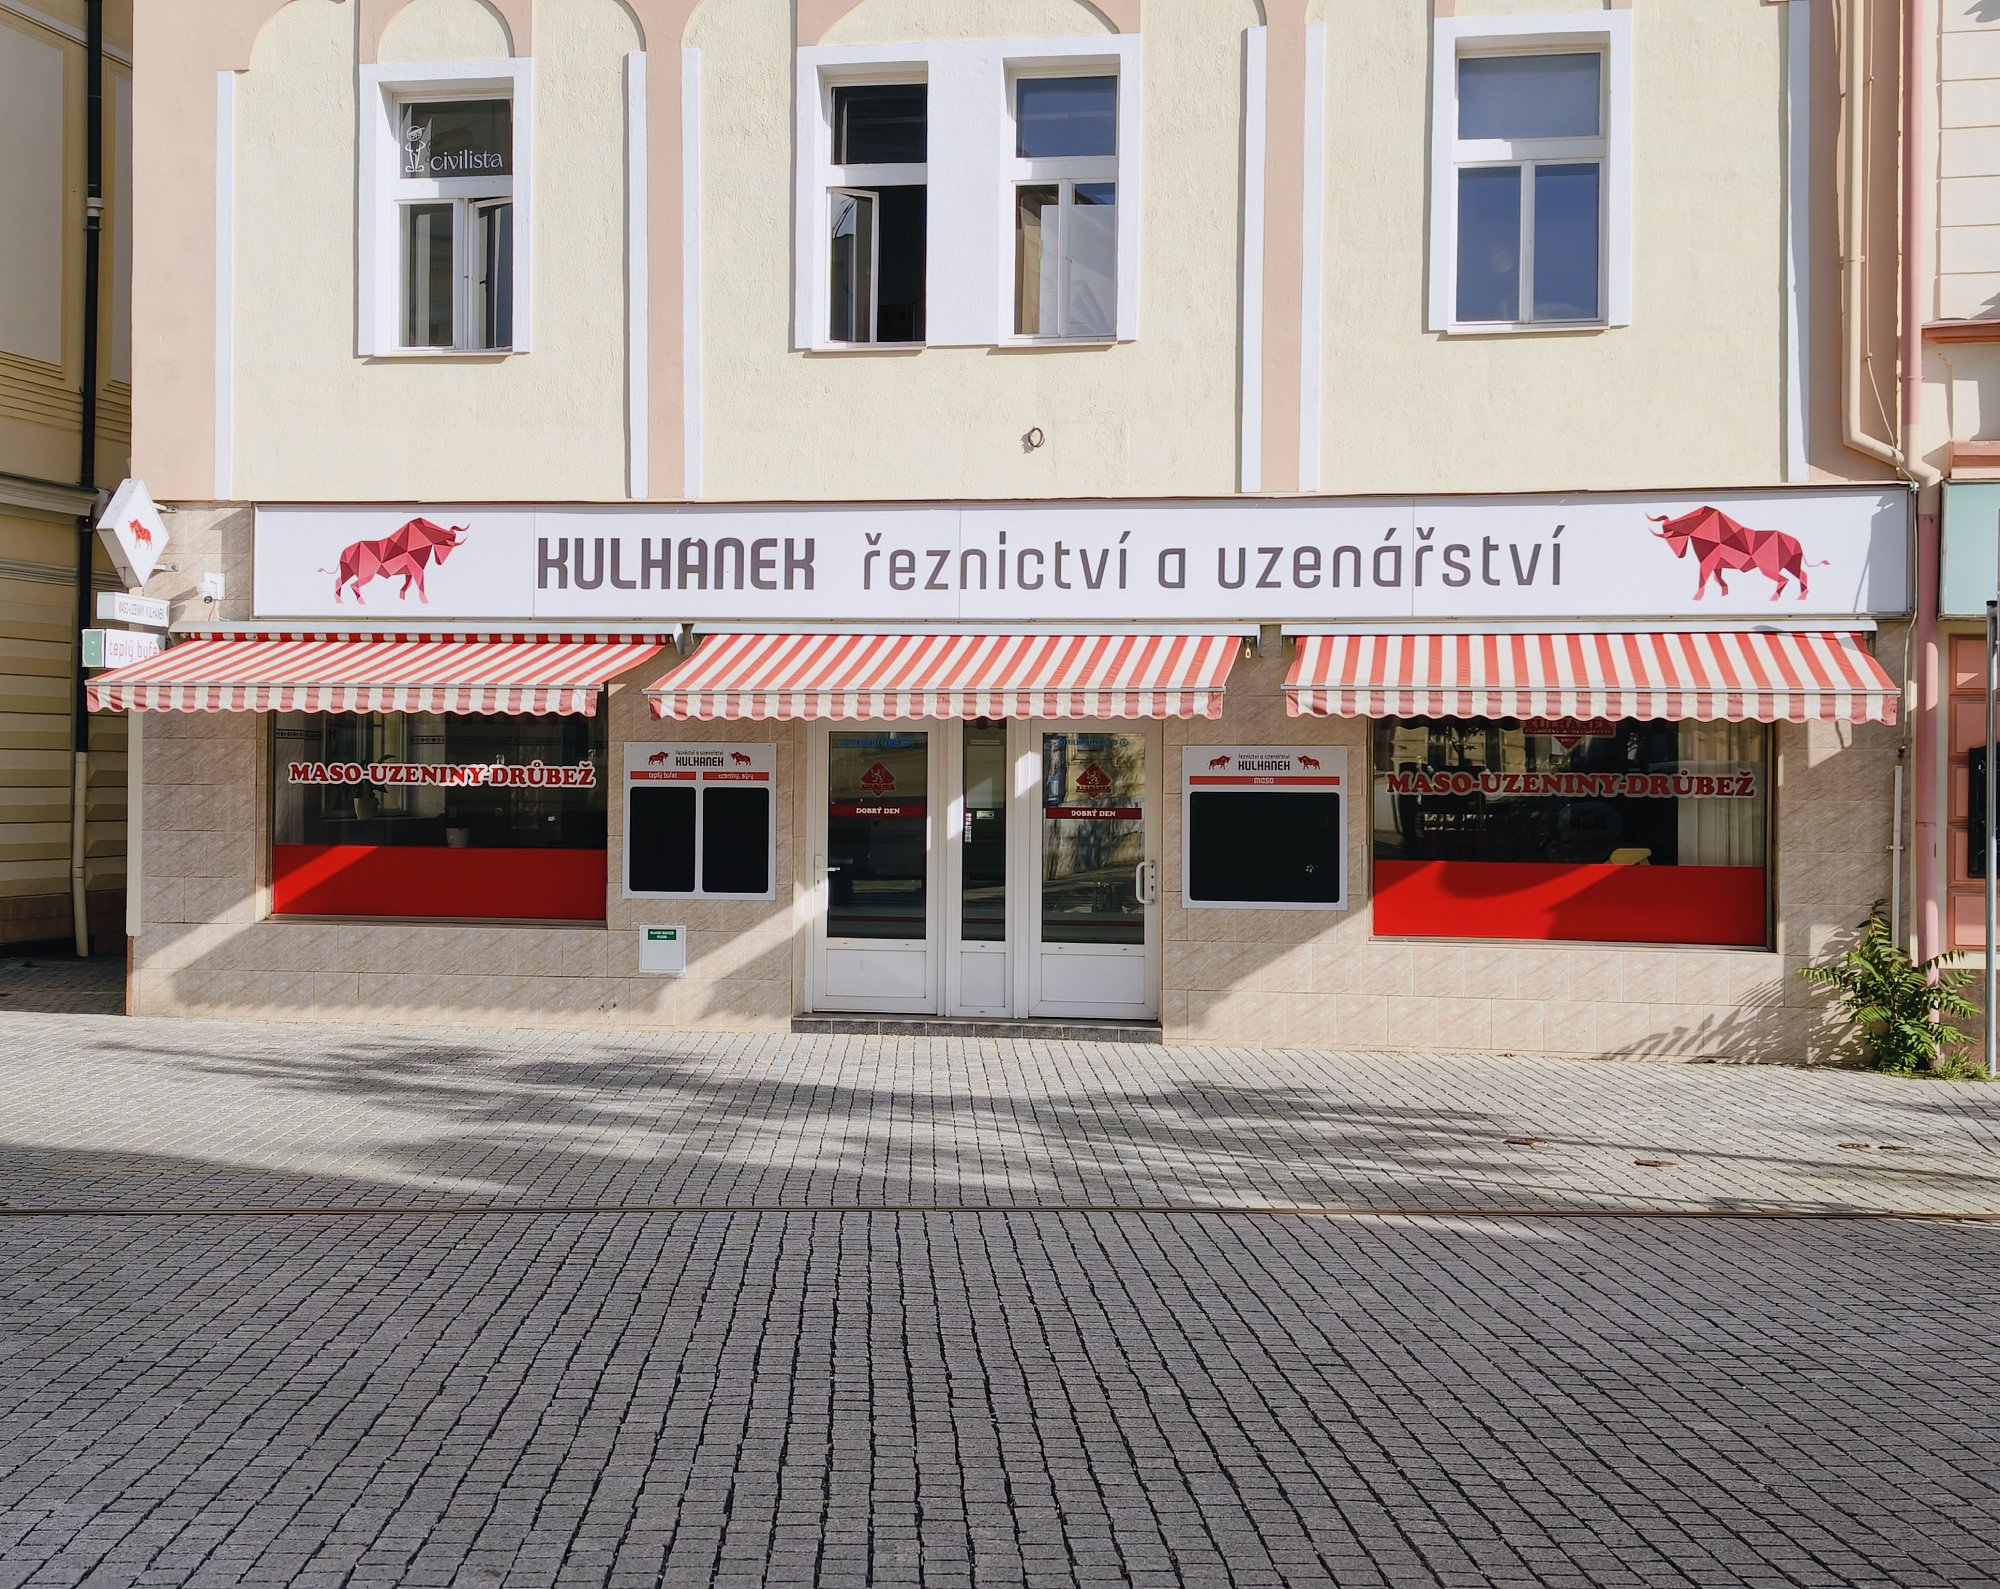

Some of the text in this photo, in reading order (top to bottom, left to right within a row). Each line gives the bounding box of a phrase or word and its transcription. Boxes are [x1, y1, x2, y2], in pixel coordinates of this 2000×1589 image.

[430, 149, 503, 171] civilista
[537, 525, 1566, 591] KULHANEK řeznictví a uzenářství
[109, 640, 161, 663] teplý bufe
[675, 756, 724, 767] KULHANEK
[1238, 760, 1290, 771] KULHANEK
[289, 760, 596, 788] MASO-UZENINY-DRŮBEŽ
[1386, 769, 1757, 798] MASO-UZENINY-DRŮBEŽ
[855, 806, 882, 814] DOBRÝ
[1071, 808, 1097, 817] DOBRÝ
